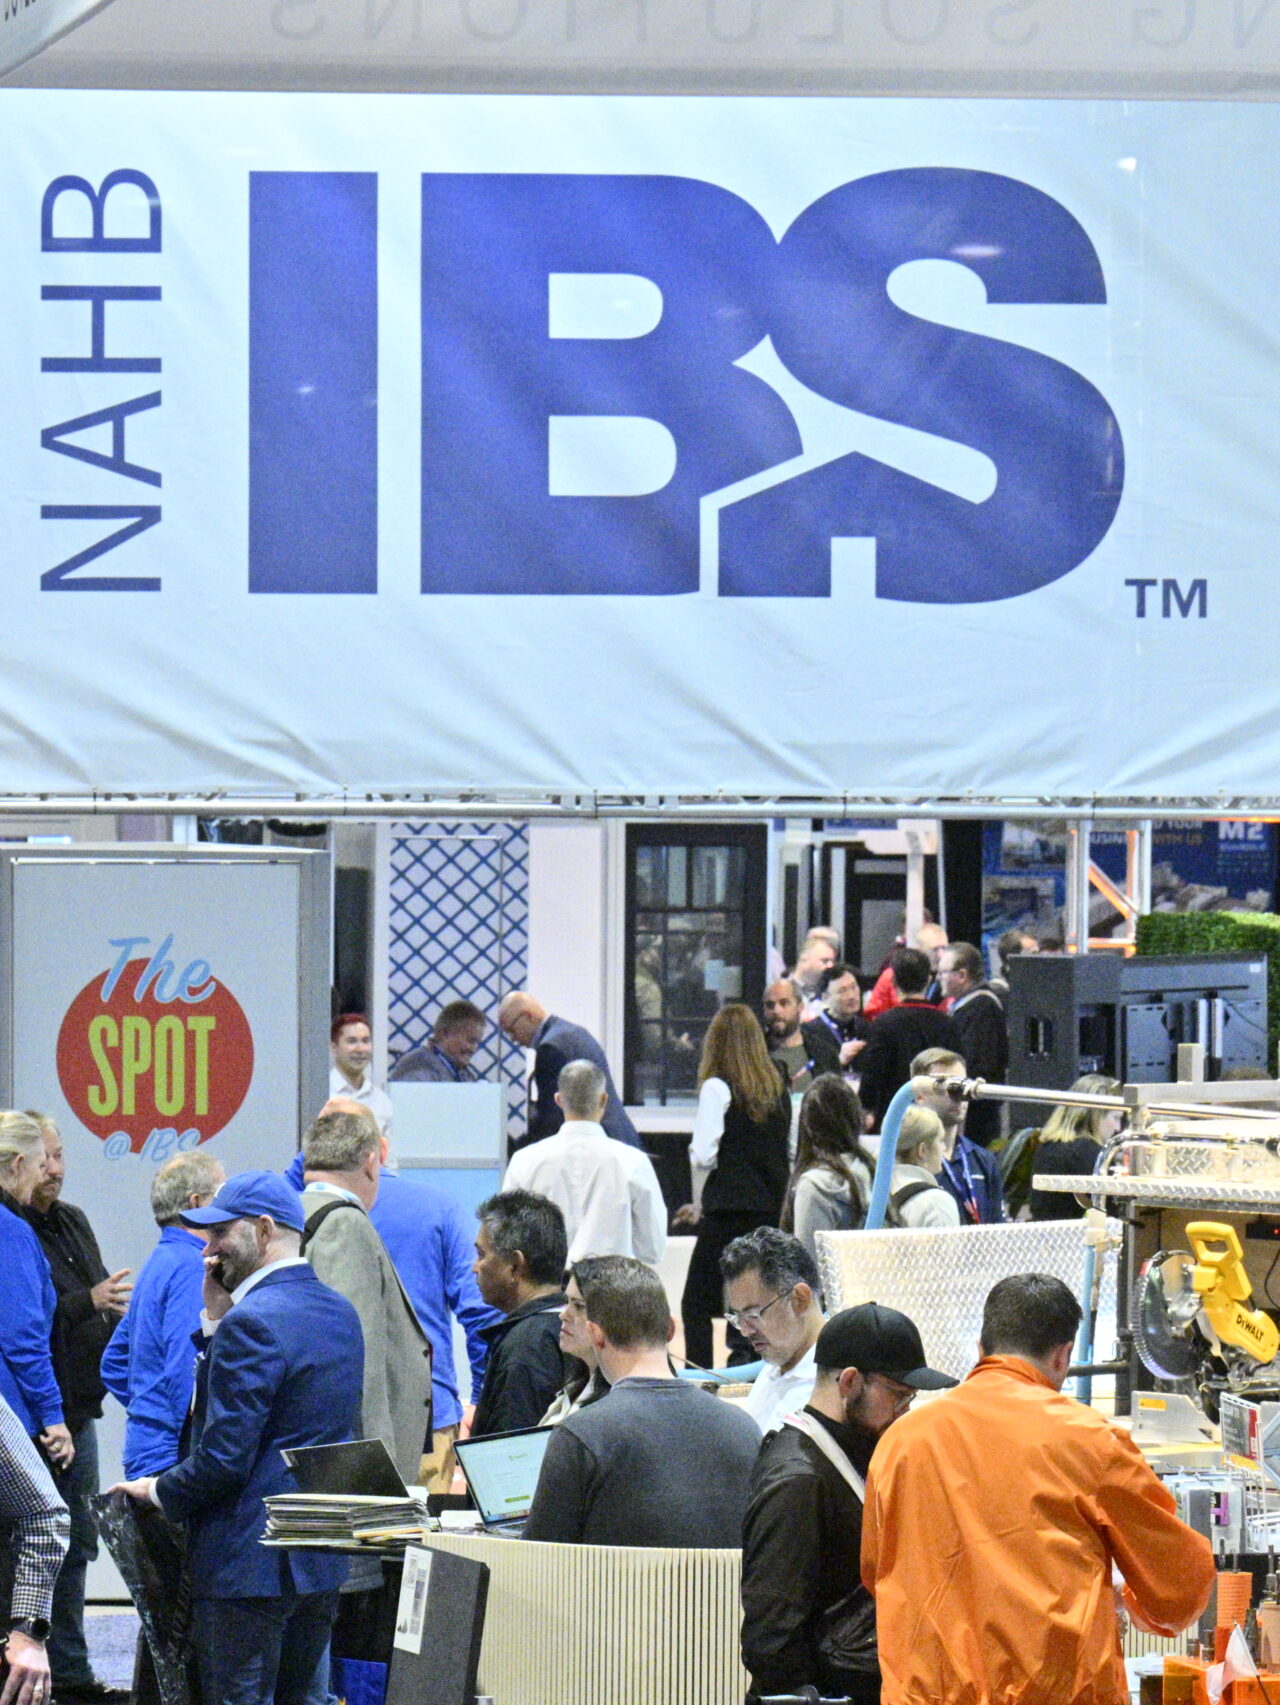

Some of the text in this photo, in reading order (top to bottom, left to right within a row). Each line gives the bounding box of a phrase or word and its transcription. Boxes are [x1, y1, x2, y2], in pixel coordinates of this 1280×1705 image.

[40, 167, 163, 593] NAHB
[248, 166, 1125, 604] IBS
[101, 933, 216, 1004] The
[87, 1014, 217, 1117] SPOT
[103, 1130, 132, 1161] @
